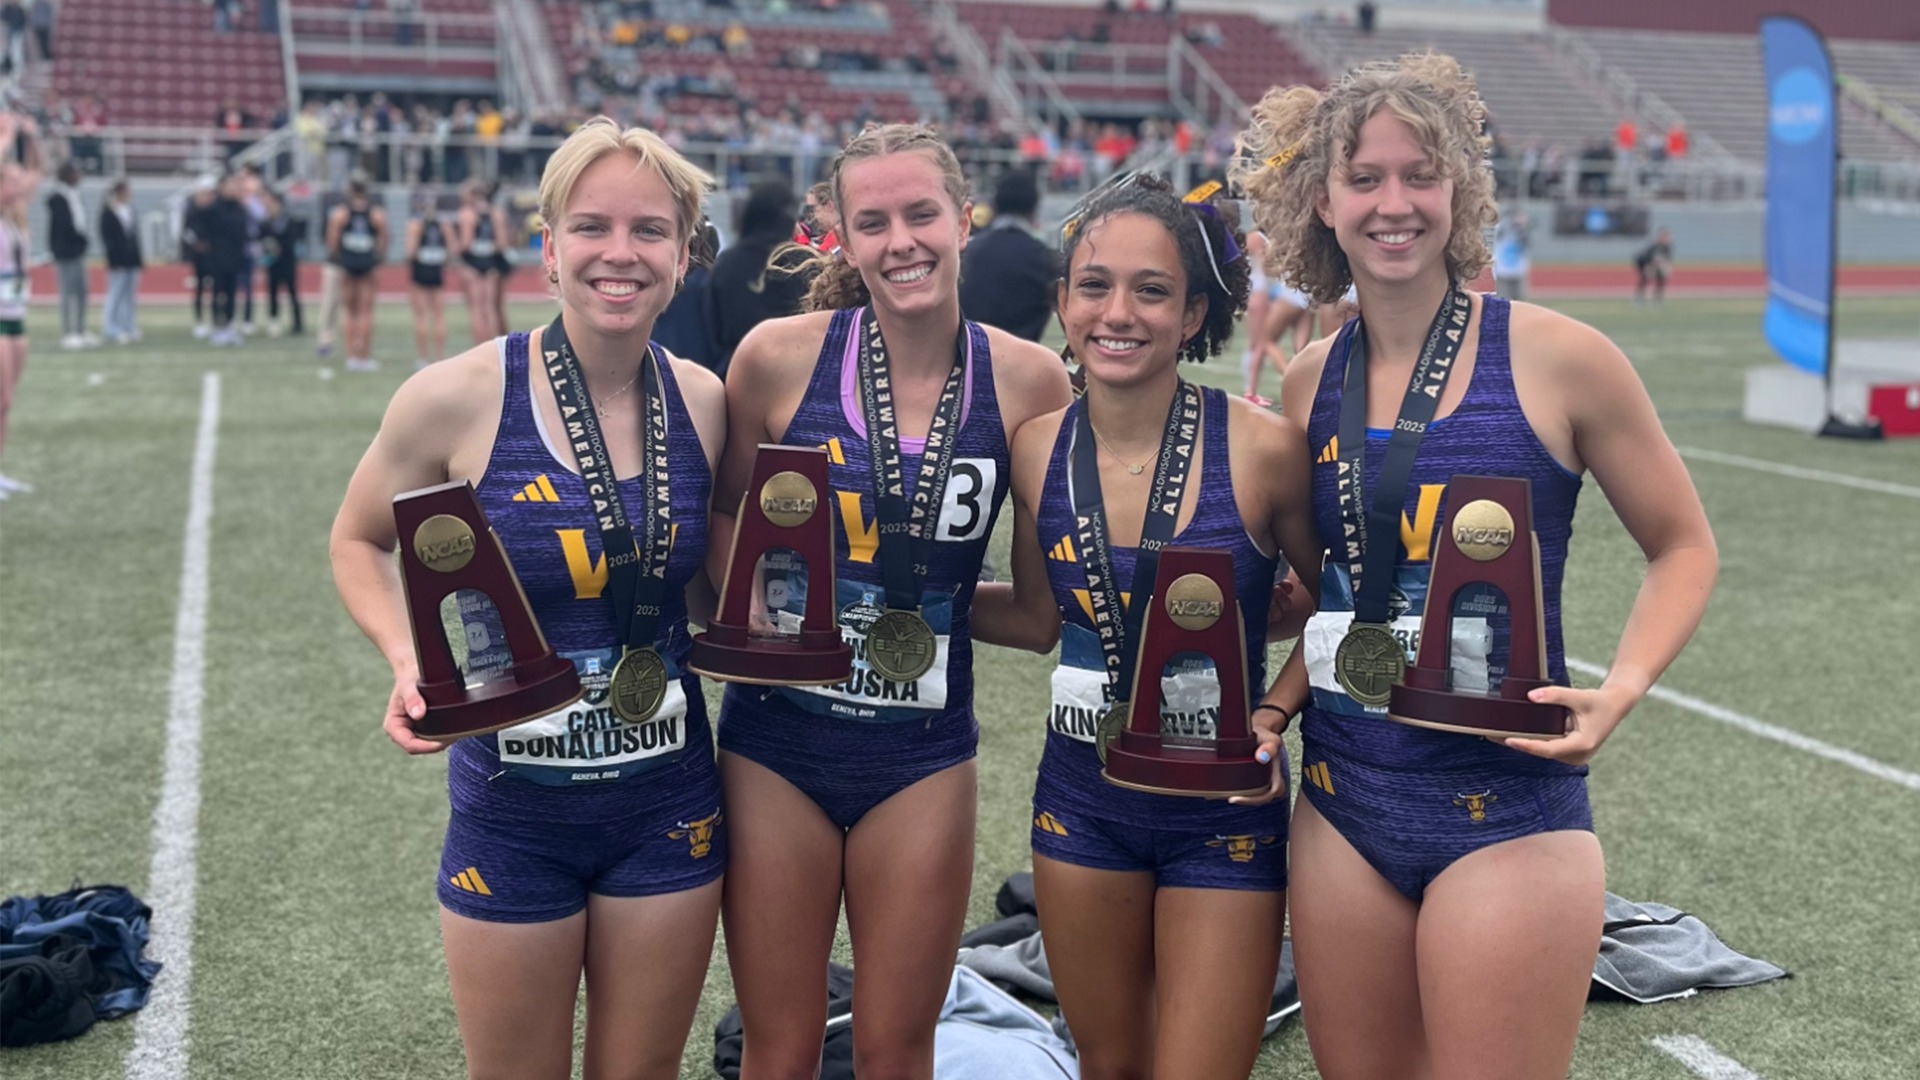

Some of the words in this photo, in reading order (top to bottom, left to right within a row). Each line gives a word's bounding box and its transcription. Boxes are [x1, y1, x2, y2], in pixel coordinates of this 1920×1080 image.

[1411, 366, 1425, 393] NCAA
[1420, 325, 1442, 366] DIVISION
[864, 377, 877, 422] OUTDOOR
[1396, 419, 1427, 434] 2025
[568, 369, 589, 411] DIVISION
[585, 418, 607, 468] OUTDOOR
[601, 466, 616, 496] TRACK
[612, 501, 625, 527] FIELD
[872, 431, 884, 472] DIVISION
[937, 435, 953, 481] OUTDOOR
[1162, 383, 1199, 516] ALL-AMERI
[646, 451, 656, 498] OUTDOOR
[877, 472, 886, 498] NCAA
[1151, 484, 1163, 513] NCAA
[1157, 443, 1173, 486] DIVISION
[1352, 458, 1361, 486] NCAA
[765, 497, 813, 514] NCAA
[948, 462, 983, 538] 3
[1353, 487, 1366, 530] DIVISION
[646, 508, 656, 550] DIVISION
[879, 522, 910, 535] 2025
[1091, 511, 1102, 539] NCAA
[1457, 527, 1509, 545] NCAA
[421, 535, 474, 562] NCAA
[608, 551, 637, 568] 2025
[642, 550, 654, 577] NCAA
[1095, 539, 1110, 580] DIVISION
[636, 604, 661, 617] 2025
[1107, 589, 1125, 638] OUTDOOR
[1170, 600, 1220, 617] NCAA
[504, 717, 678, 760] DONALDSON
